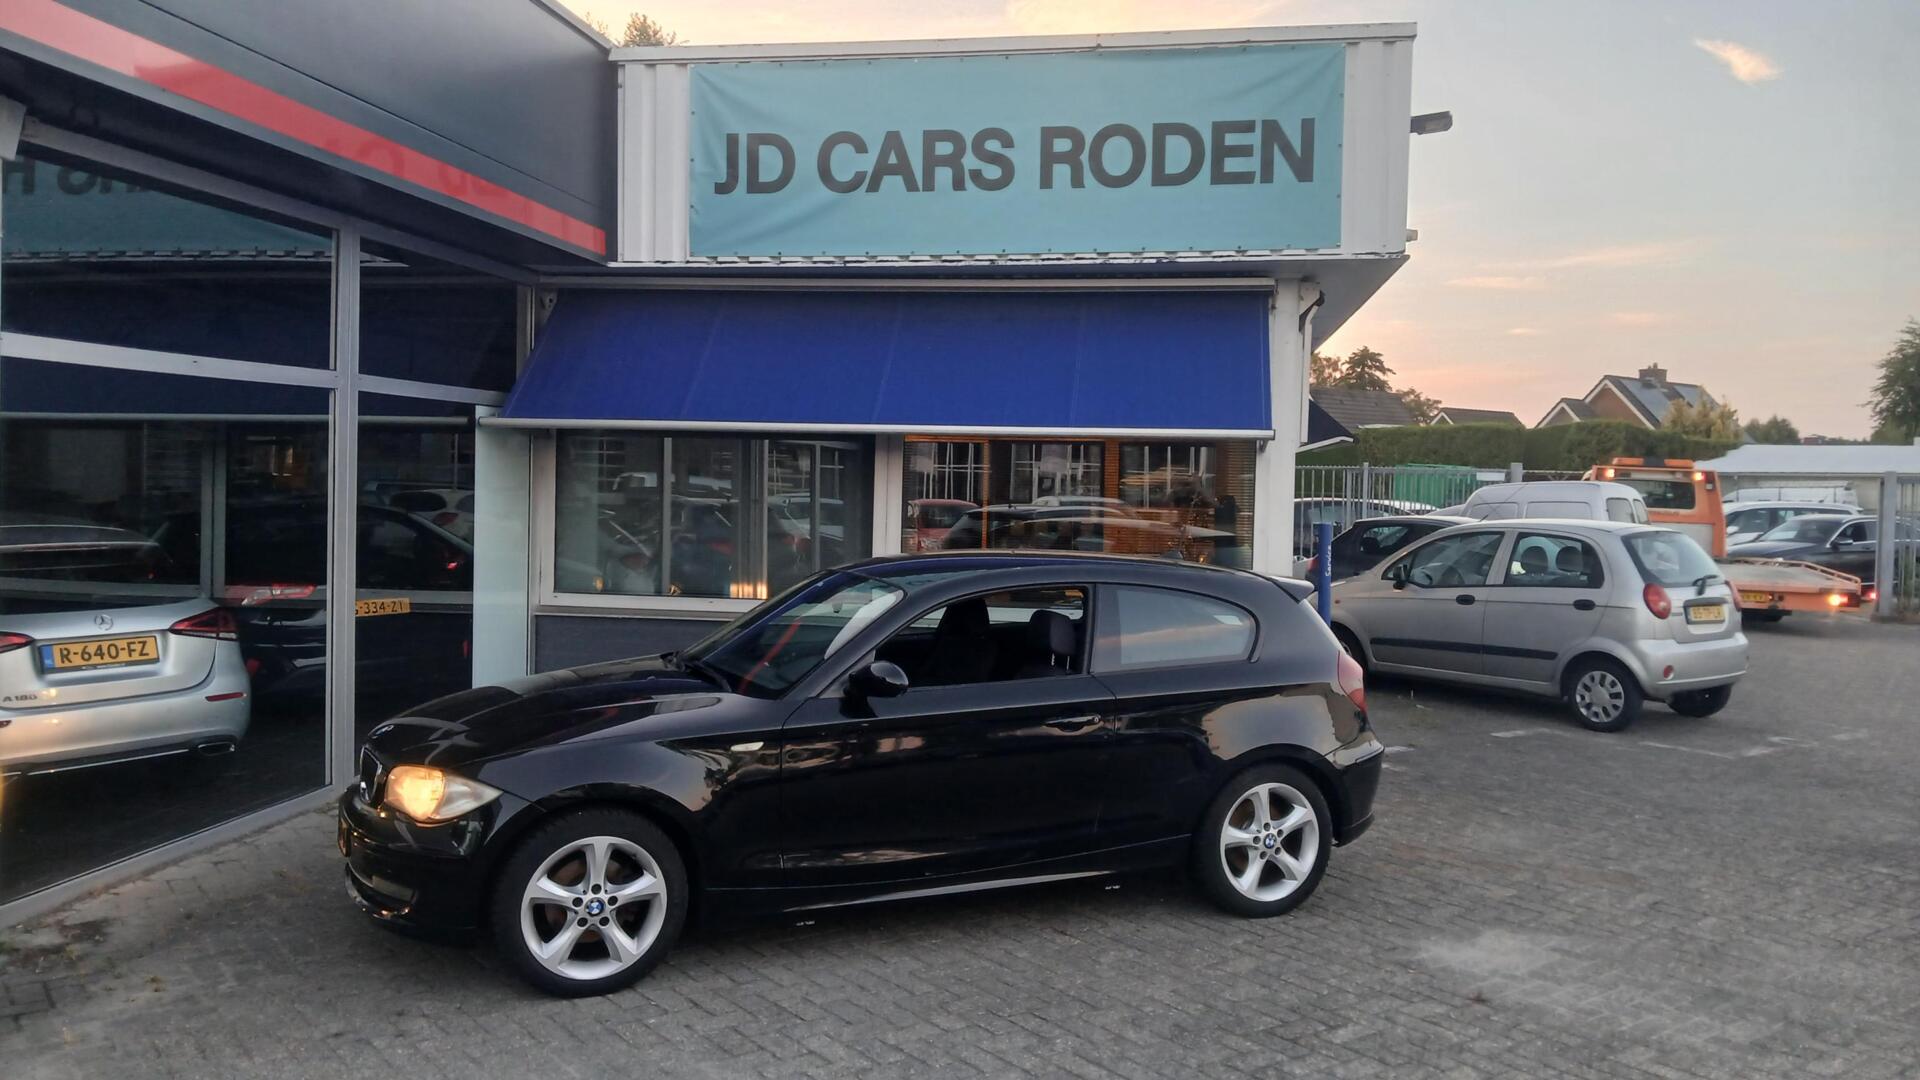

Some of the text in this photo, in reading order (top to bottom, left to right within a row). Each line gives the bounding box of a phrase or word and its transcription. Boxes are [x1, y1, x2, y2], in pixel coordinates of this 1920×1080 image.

[714, 117, 1316, 195] JD CARS RODEN
[59, 640, 150, 664] R-640-FZ
